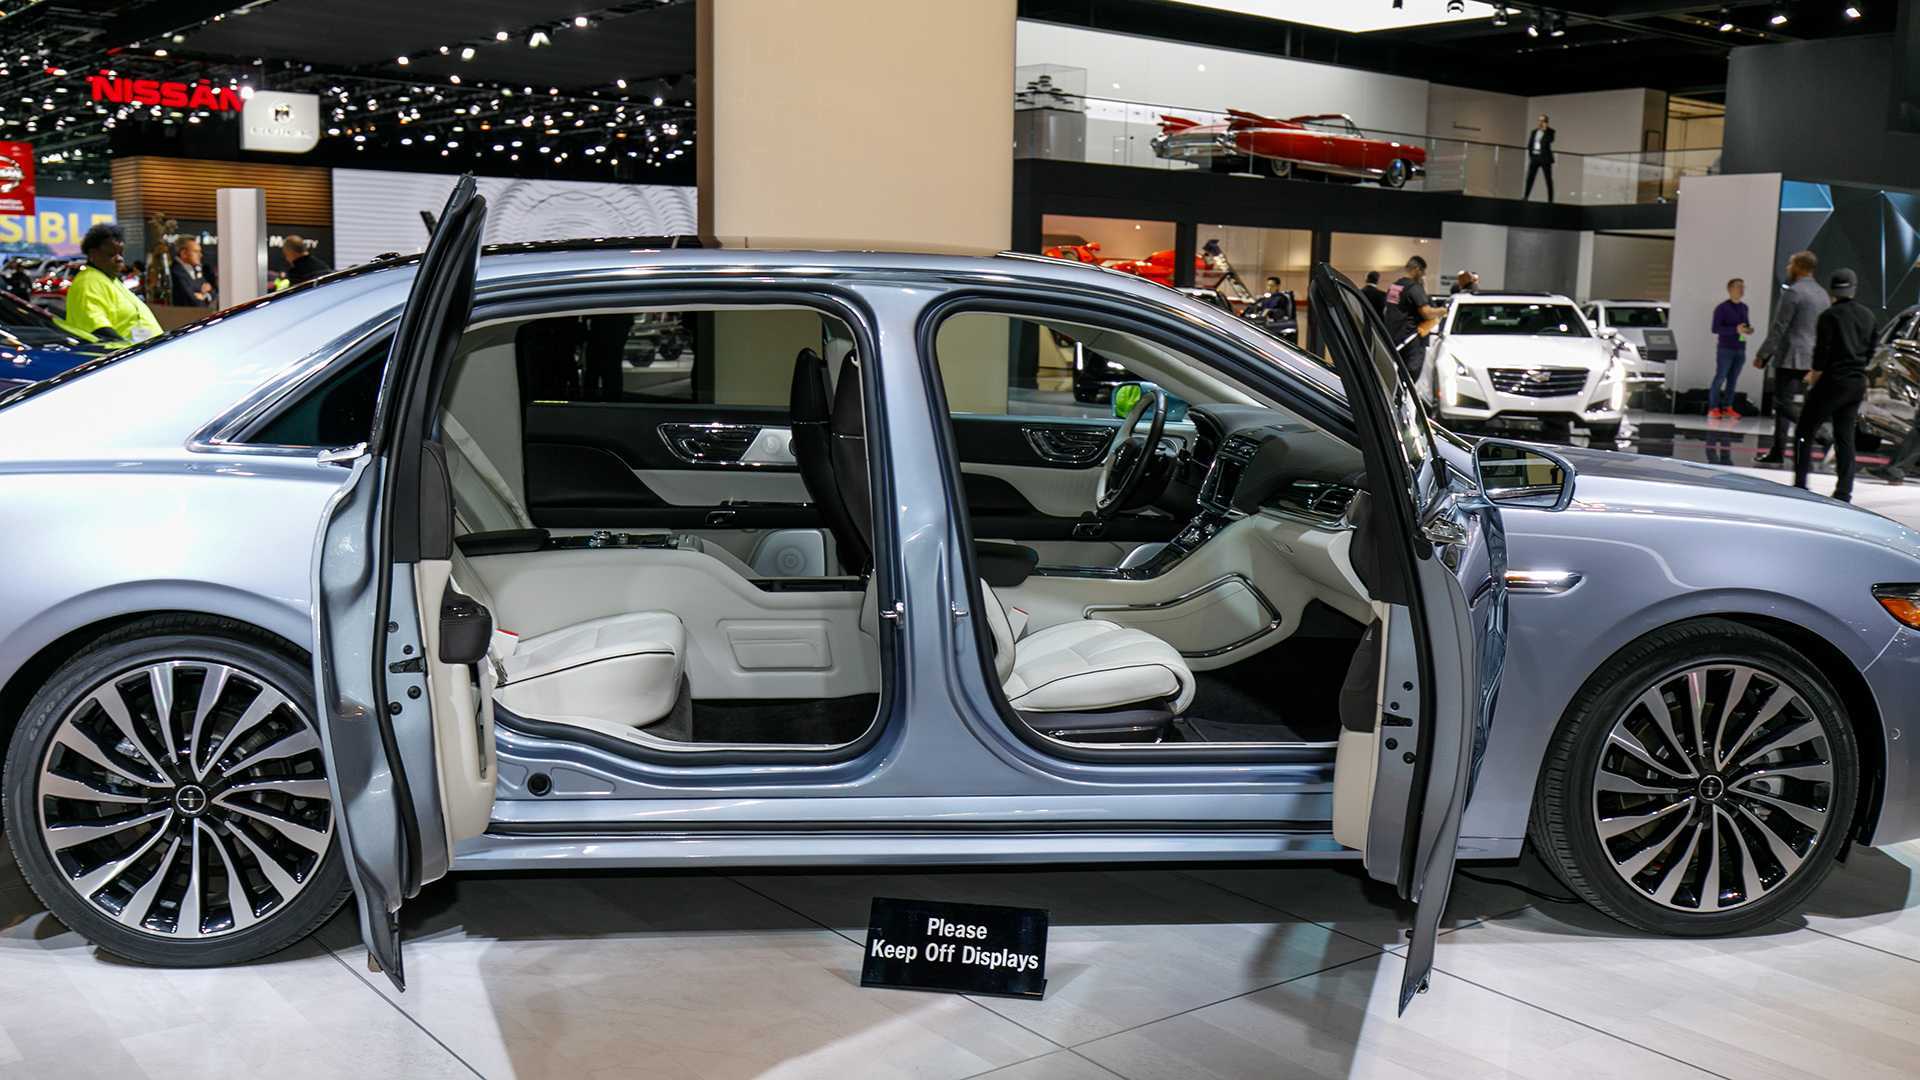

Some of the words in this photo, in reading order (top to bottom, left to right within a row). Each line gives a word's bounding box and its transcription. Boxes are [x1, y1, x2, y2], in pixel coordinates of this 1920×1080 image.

[90, 76, 242, 113] NISSAN
[0, 211, 113, 244] SIBL
[927, 917, 988, 940] Please
[871, 938, 918, 963] Keep
[925, 942, 956, 963] Off
[962, 945, 1039, 972] Displays
